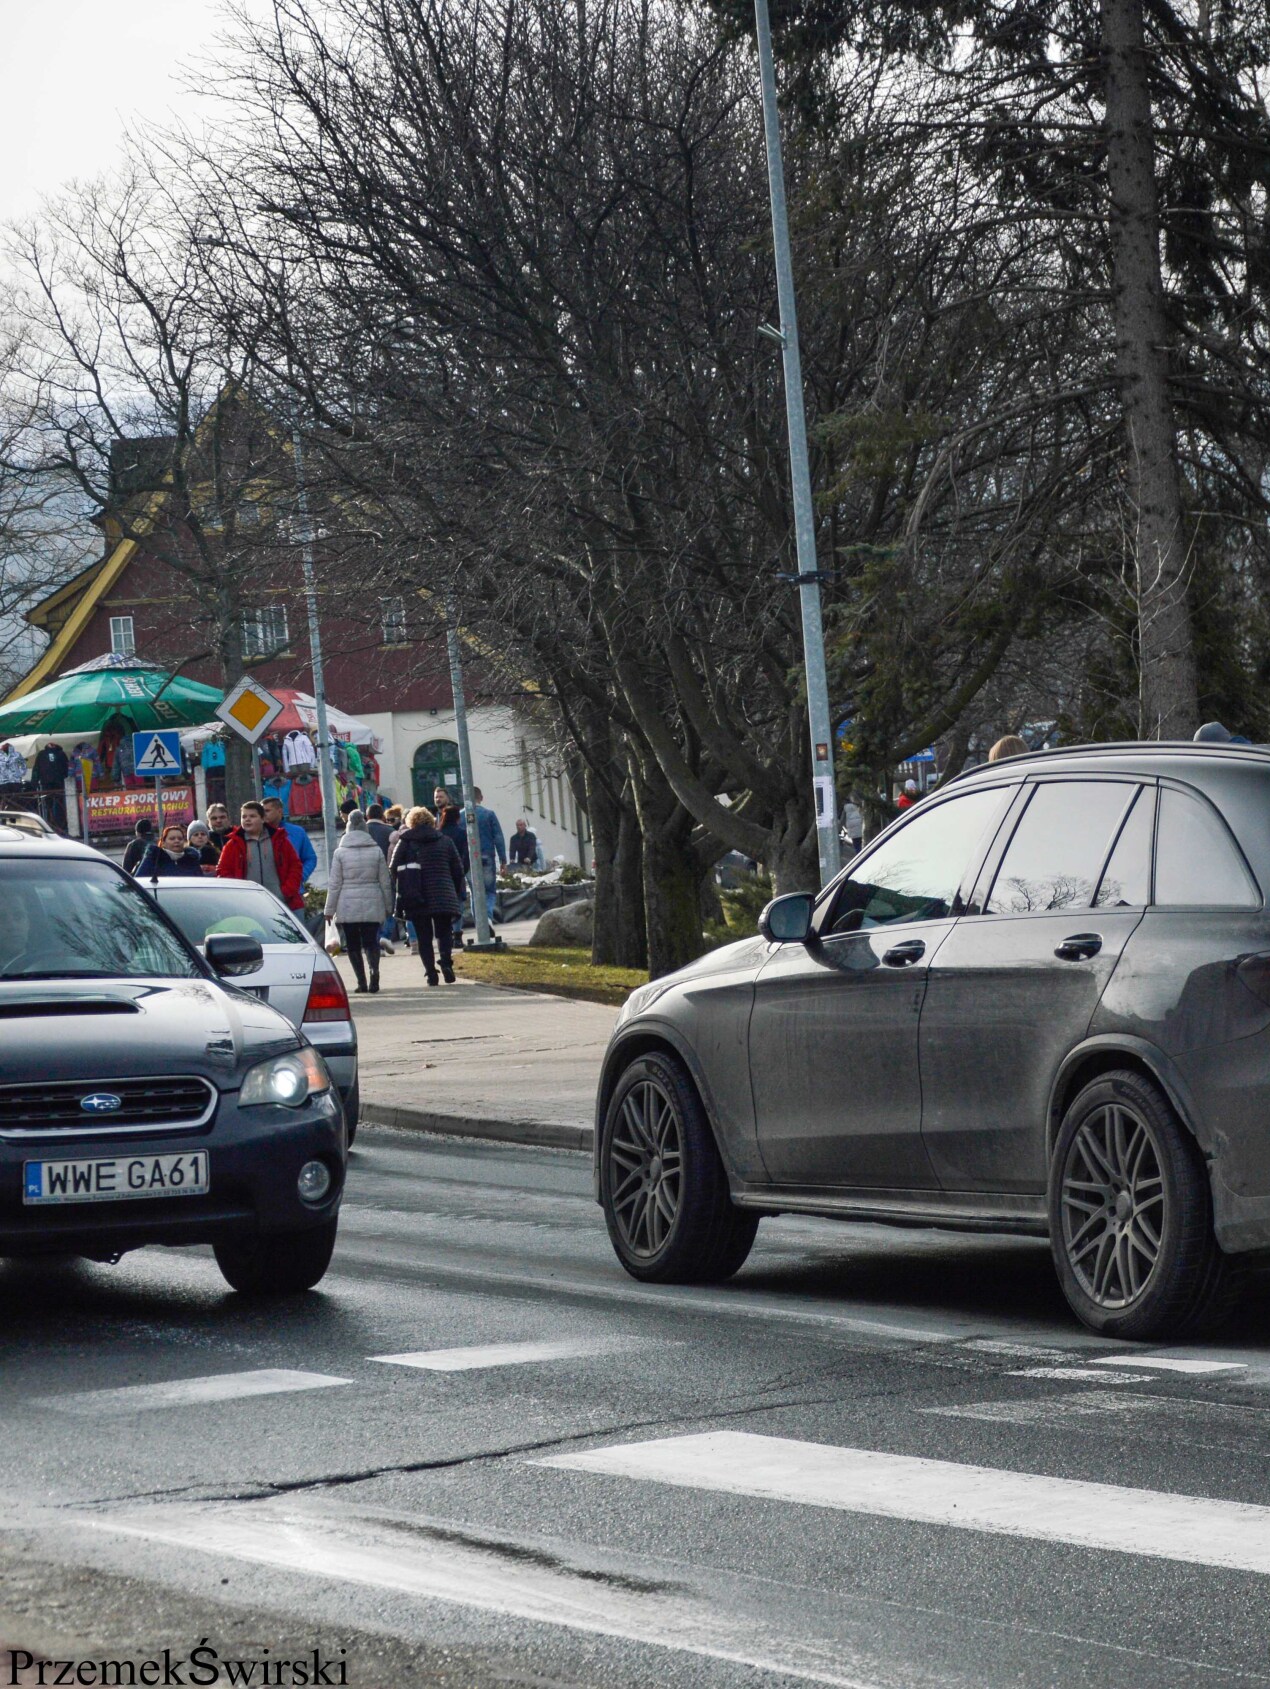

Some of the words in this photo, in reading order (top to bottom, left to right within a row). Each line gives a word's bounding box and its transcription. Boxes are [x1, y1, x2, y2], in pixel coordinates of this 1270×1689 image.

[92, 804, 152, 817] RESTAURACJA
[48, 1160, 117, 1194] WWE
[127, 1155, 201, 1189] GA61
[28, 1184, 40, 1194] PL
